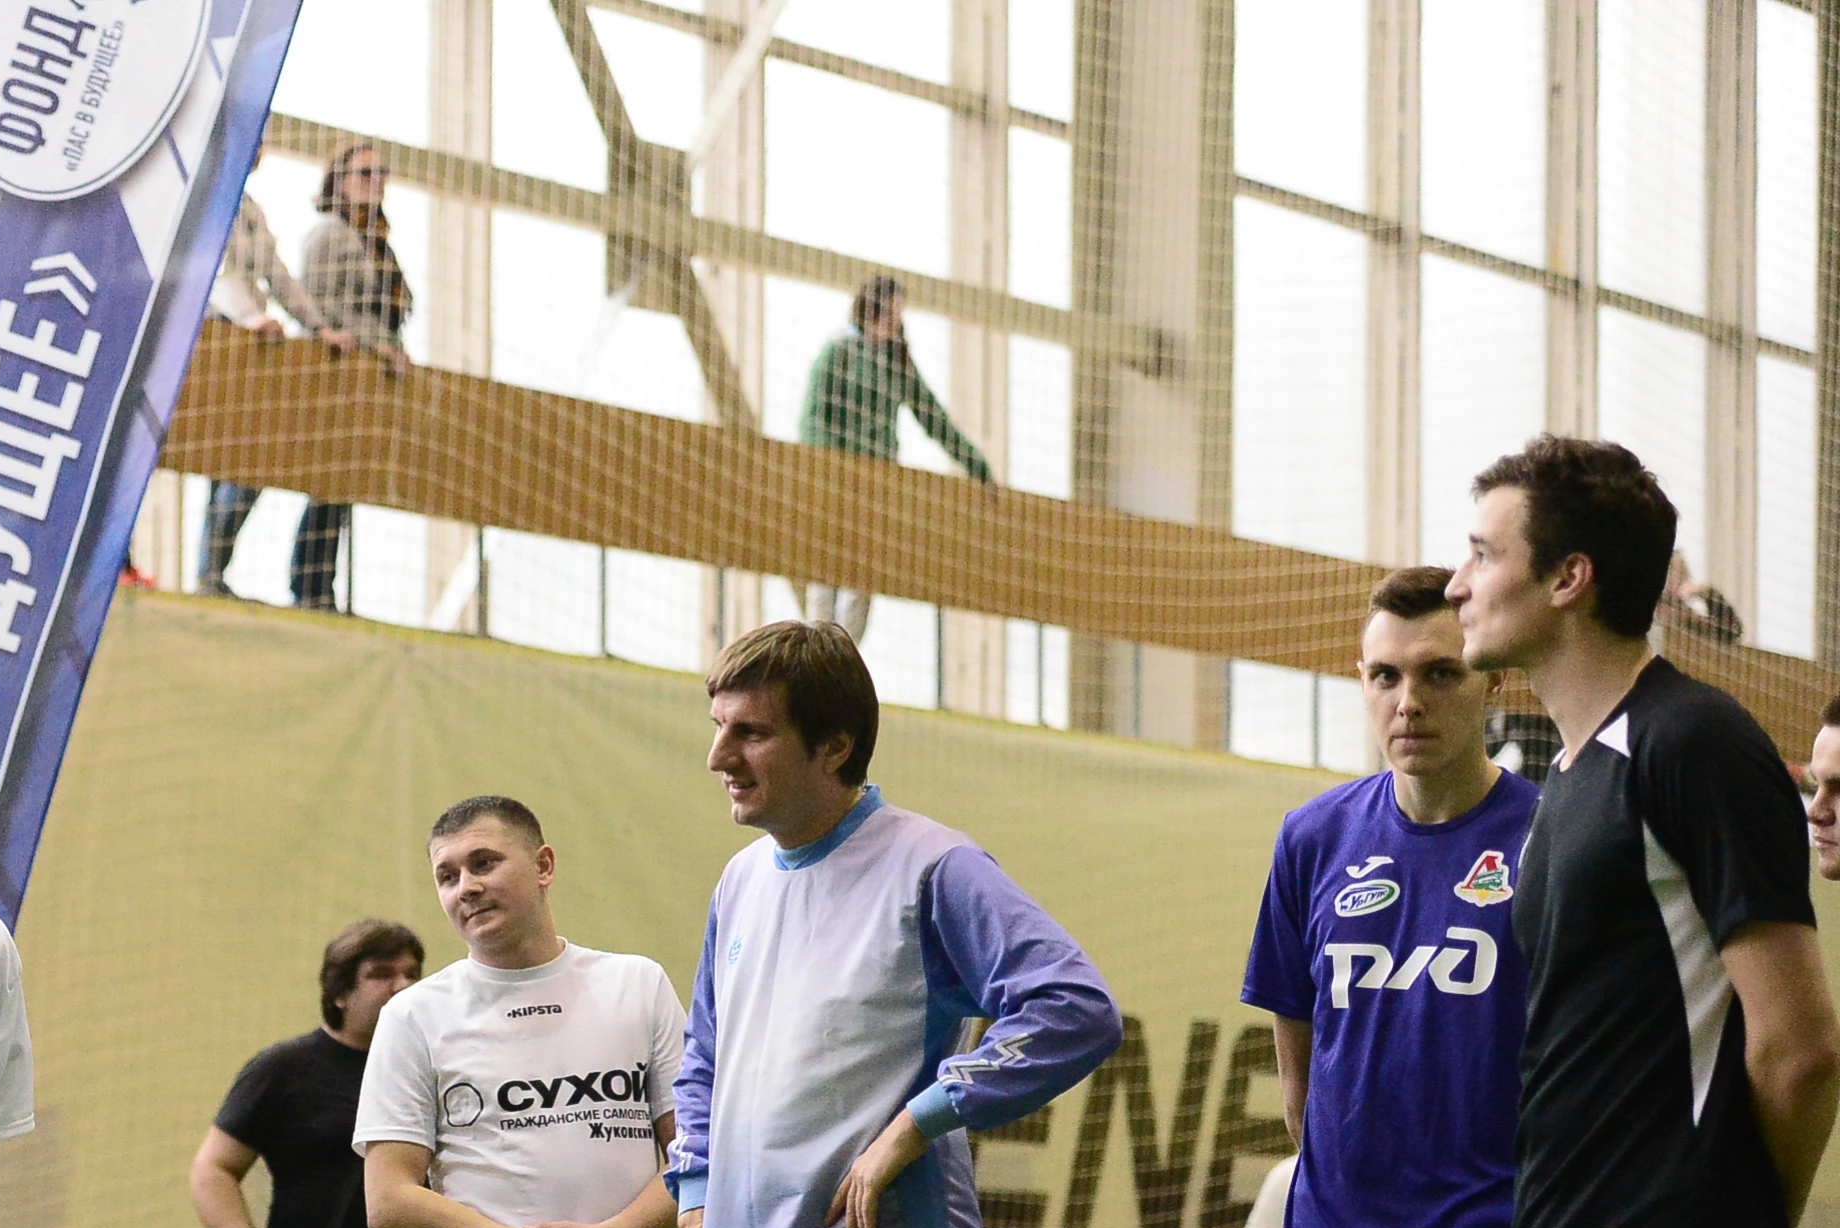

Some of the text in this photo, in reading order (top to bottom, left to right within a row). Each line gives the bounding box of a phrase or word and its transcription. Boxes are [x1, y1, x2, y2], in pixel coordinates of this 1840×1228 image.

[79, 20, 126, 109] БУДУЩЕЕ»
[74, 110, 97, 126] В
[496, 1061, 648, 1113] СУХОЙ
[499, 1109, 601, 1131] ГРАЖДАНСКИЕ
